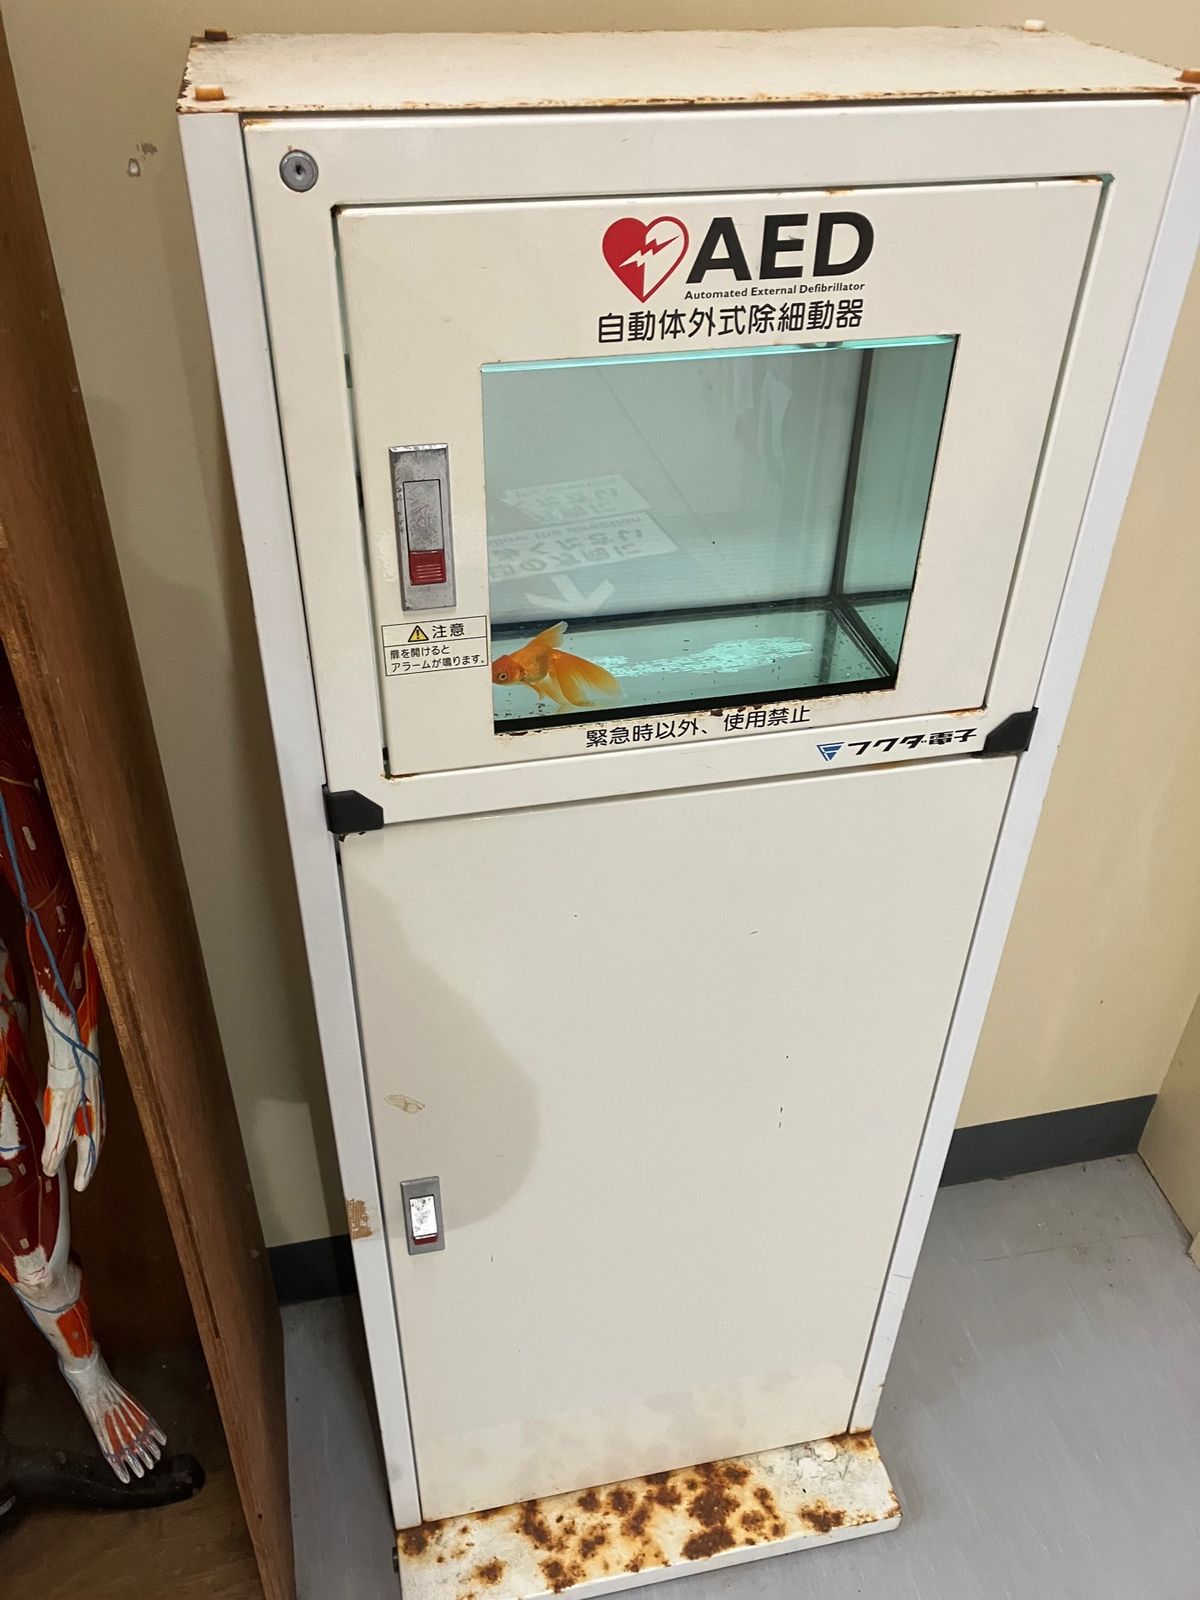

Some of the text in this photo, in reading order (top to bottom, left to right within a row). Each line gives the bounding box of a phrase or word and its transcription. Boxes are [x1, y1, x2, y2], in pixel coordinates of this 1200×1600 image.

[685, 211, 875, 284] AED
[684, 282, 866, 300] Automated External Defibrillator
[598, 299, 864, 344] 自動体外式除細動器
[431, 622, 465, 639] 注意
[390, 644, 450, 660] 扉を開けると
[586, 705, 811, 748] 緊急時以外、使用禁止
[847, 728, 978, 756] フクダ電子
